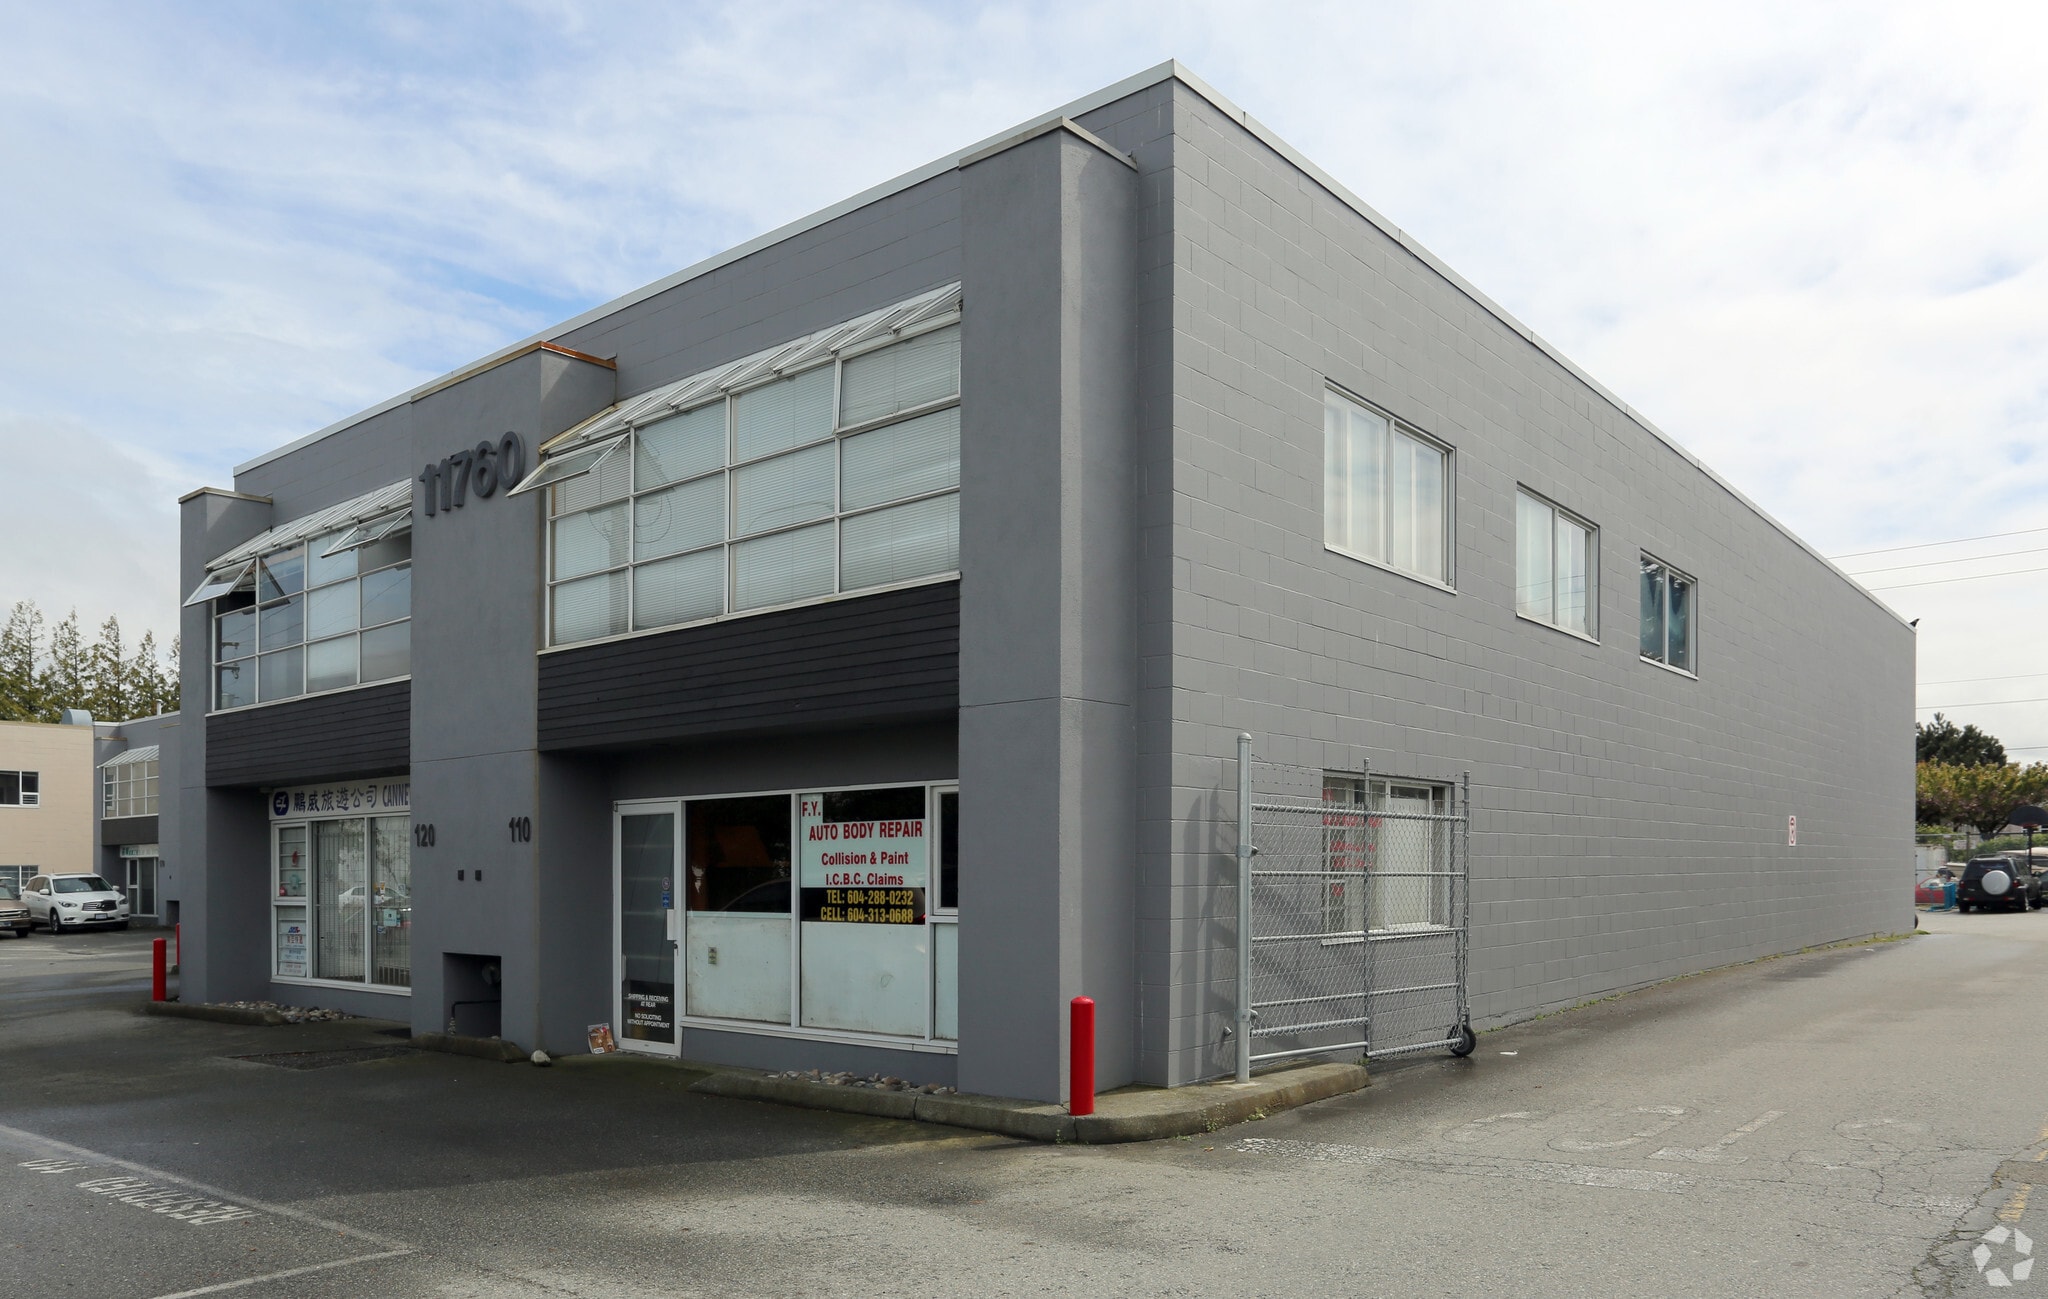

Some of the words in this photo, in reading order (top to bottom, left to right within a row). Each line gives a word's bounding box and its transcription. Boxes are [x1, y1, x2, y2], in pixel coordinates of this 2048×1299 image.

[419, 431, 525, 517] 11760
[382, 783, 410, 807] CANNE
[802, 801, 822, 817] F.Y.
[414, 824, 436, 847] 120
[509, 816, 531, 843] 110
[809, 824, 838, 841] AUTO
[843, 823, 875, 840] BODY
[879, 821, 923, 839] REPAIR
[821, 852, 867, 866] Collision
[869, 851, 877, 865] &
[880, 851, 909, 865] Paint
[825, 872, 865, 886] I.C.B.C.
[867, 873, 904, 886] Claims
[826, 889, 846, 904] TEL:
[847, 890, 914, 906] 604-288-0232
[820, 907, 845, 921] CELL:
[847, 908, 914, 923] 604-313-0688
[75, 1176, 262, 1226] RESERVED
